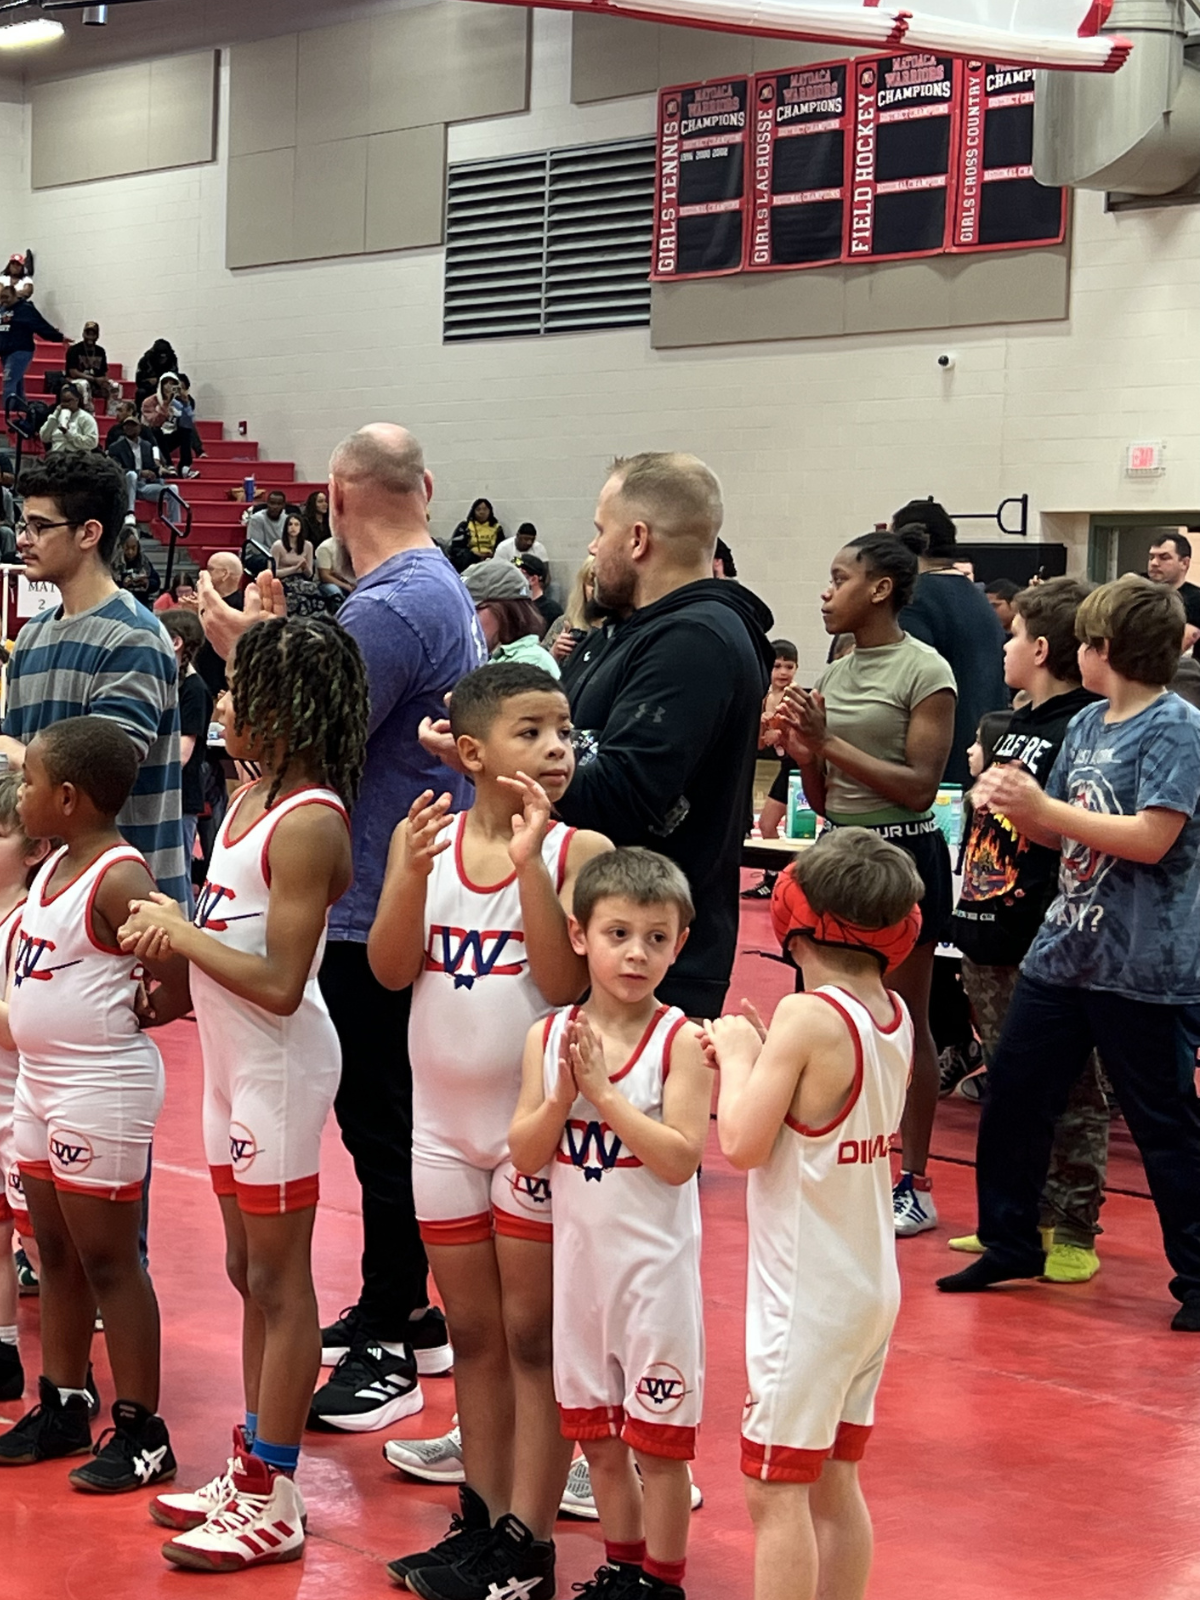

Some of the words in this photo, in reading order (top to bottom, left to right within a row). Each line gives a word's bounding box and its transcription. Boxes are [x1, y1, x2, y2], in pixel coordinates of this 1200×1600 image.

[776, 97, 843, 122] CHAMPIONS
[877, 81, 951, 107] CHAMPIONS
[966, 77, 981, 146] COUNTRY
[681, 111, 745, 135] CHAMPIONS
[855, 93, 875, 182] HOCKEY
[662, 121, 679, 203] TENNIS
[756, 109, 773, 203] LACROSSE
[963, 148, 979, 196] CROSS
[658, 208, 676, 272] GIRLS
[754, 209, 769, 263] GIRLS
[851, 186, 873, 253] FIELD
[959, 198, 976, 242] GIRLS
[28, 582, 55, 593] MAT
[38, 598, 46, 610] 2
